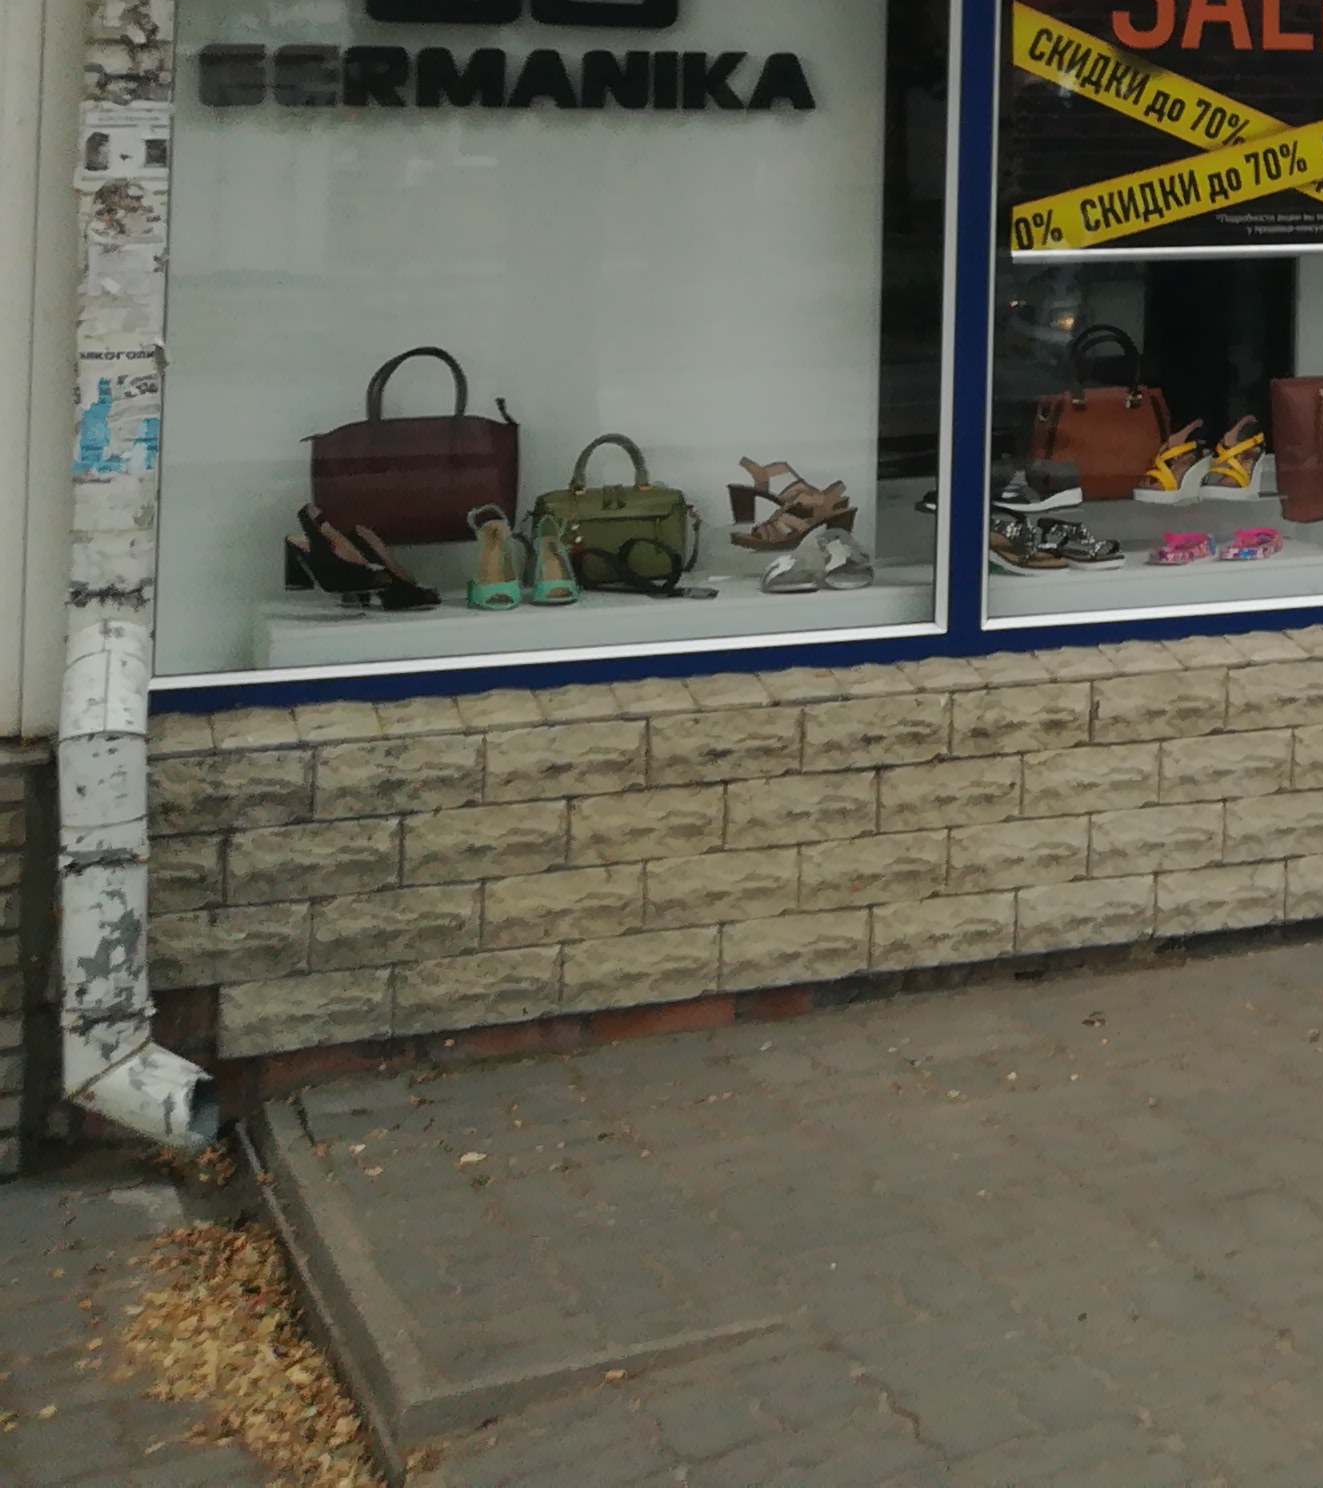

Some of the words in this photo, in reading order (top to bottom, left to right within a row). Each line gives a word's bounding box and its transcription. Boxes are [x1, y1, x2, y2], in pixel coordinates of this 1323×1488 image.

[199, 43, 816, 111] GERMANIKA
[1028, 27, 1151, 106] СКИДКИ
[1190, 97, 1250, 147] 70%
[1080, 169, 1201, 233] СКИДКИ
[1243, 140, 1308, 186] 70%
